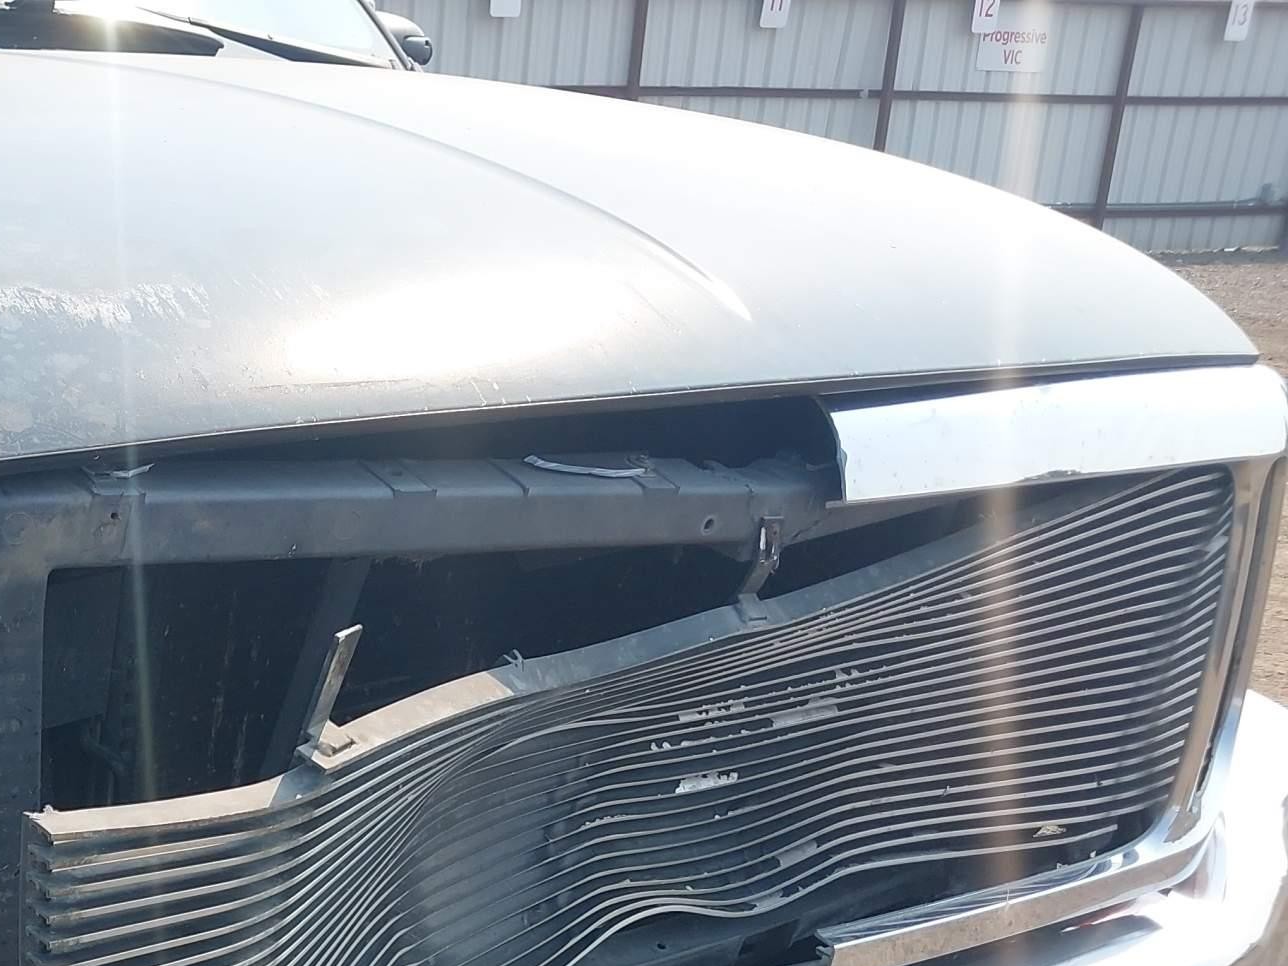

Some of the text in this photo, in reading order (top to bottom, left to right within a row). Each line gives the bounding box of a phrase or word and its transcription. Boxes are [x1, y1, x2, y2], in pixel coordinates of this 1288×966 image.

[978, 0, 996, 17] 12
[1232, 3, 1248, 26] 13
[982, 29, 1047, 45] Progressive
[1003, 49, 1022, 65] VIC
